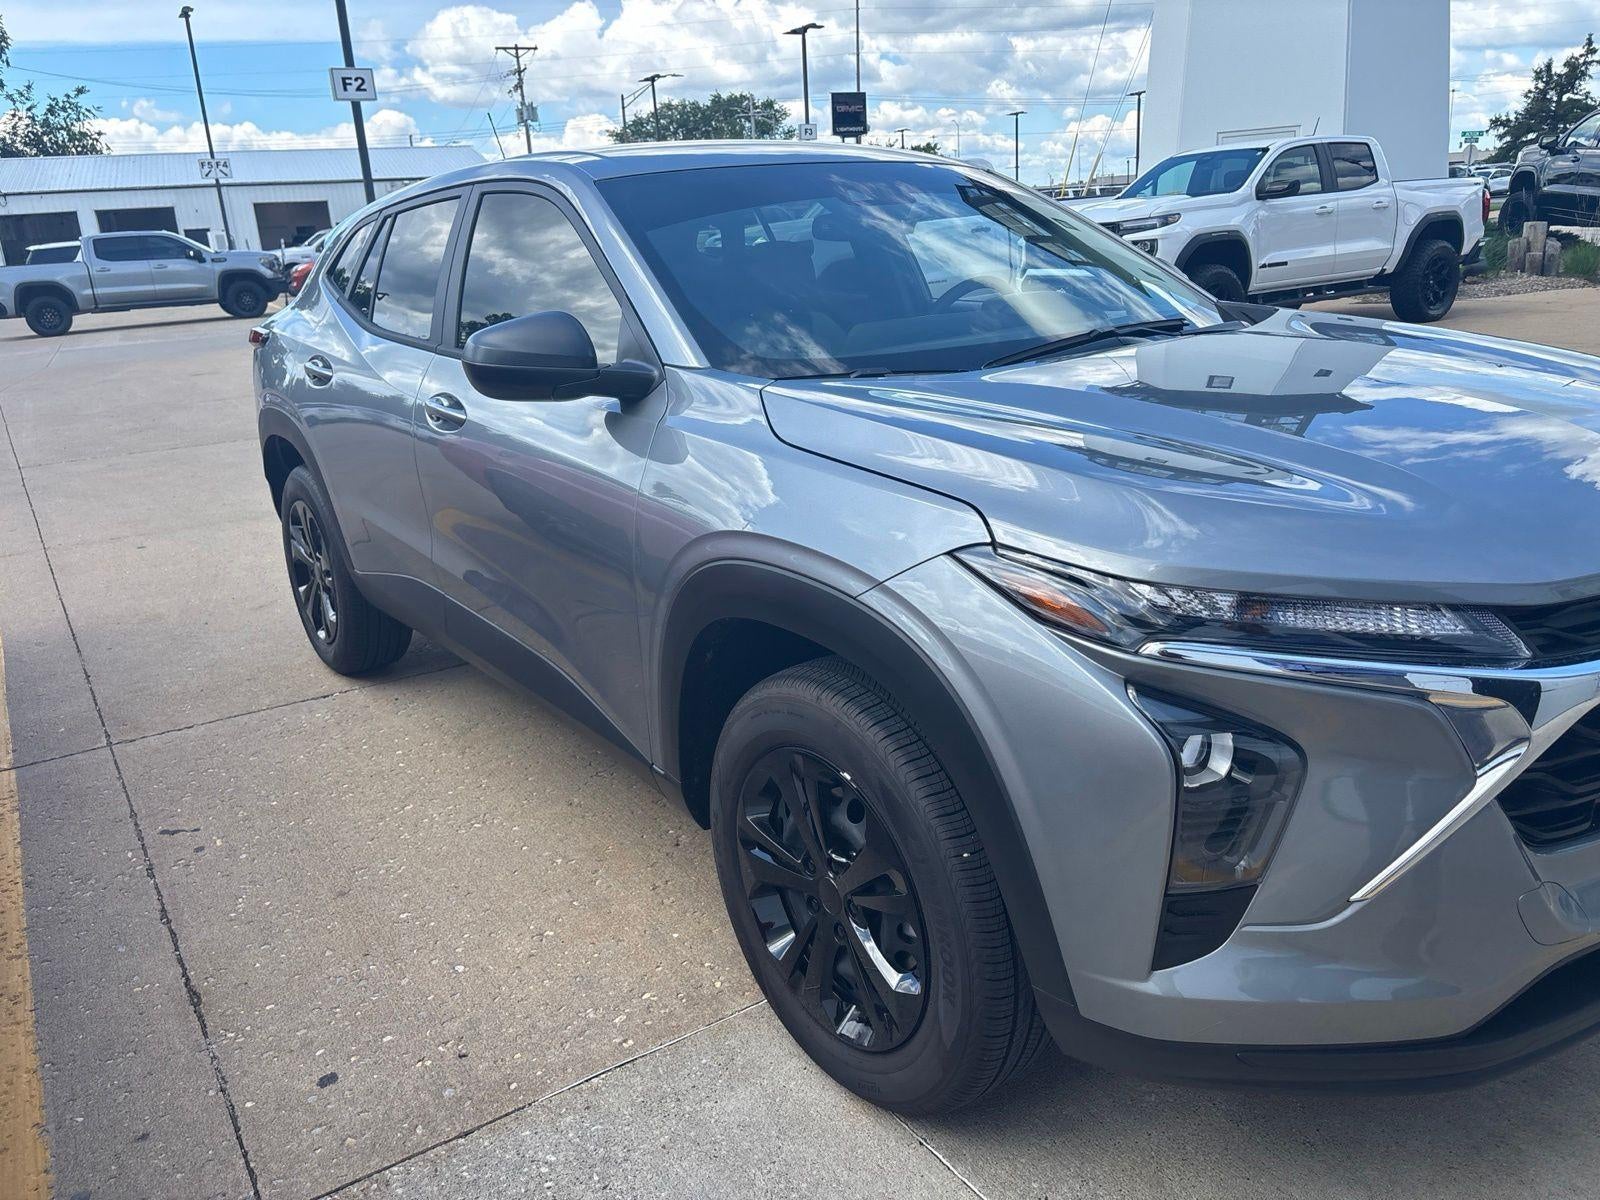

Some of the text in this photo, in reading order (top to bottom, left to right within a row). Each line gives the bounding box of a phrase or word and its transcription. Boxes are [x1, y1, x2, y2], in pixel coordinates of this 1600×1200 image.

[341, 76, 367, 92] F2
[804, 128, 813, 136] F3
[200, 161, 228, 169] F5 F4
